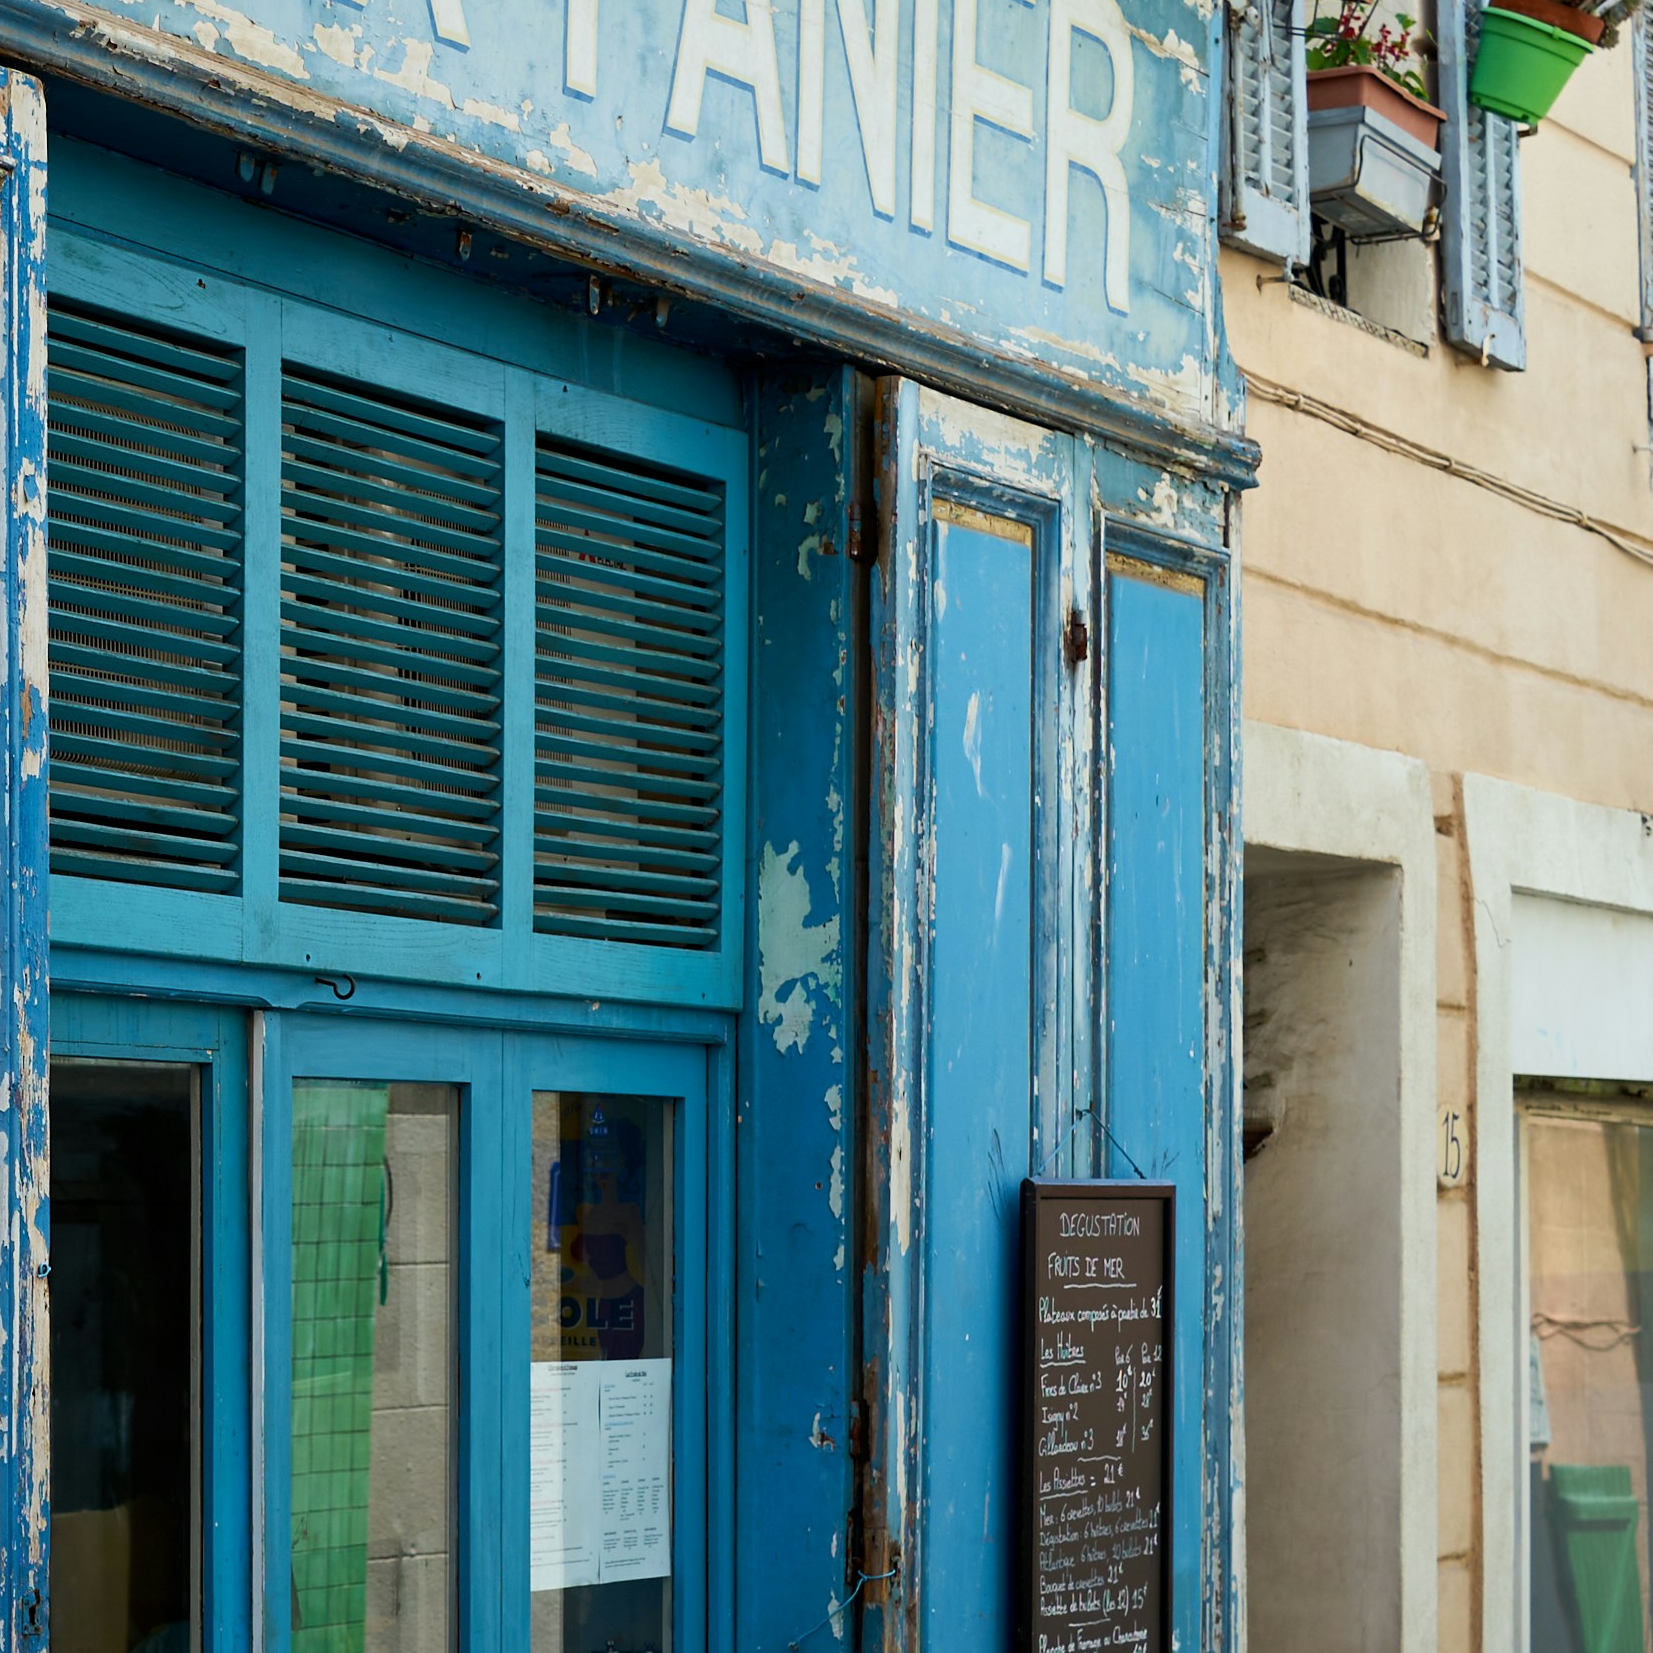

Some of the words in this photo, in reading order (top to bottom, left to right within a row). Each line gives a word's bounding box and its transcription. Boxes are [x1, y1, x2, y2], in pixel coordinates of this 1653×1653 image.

[1441, 1111, 1461, 1179] 15
[1085, 1257, 1099, 1277] DE
[1103, 1257, 1125, 1279] MER
